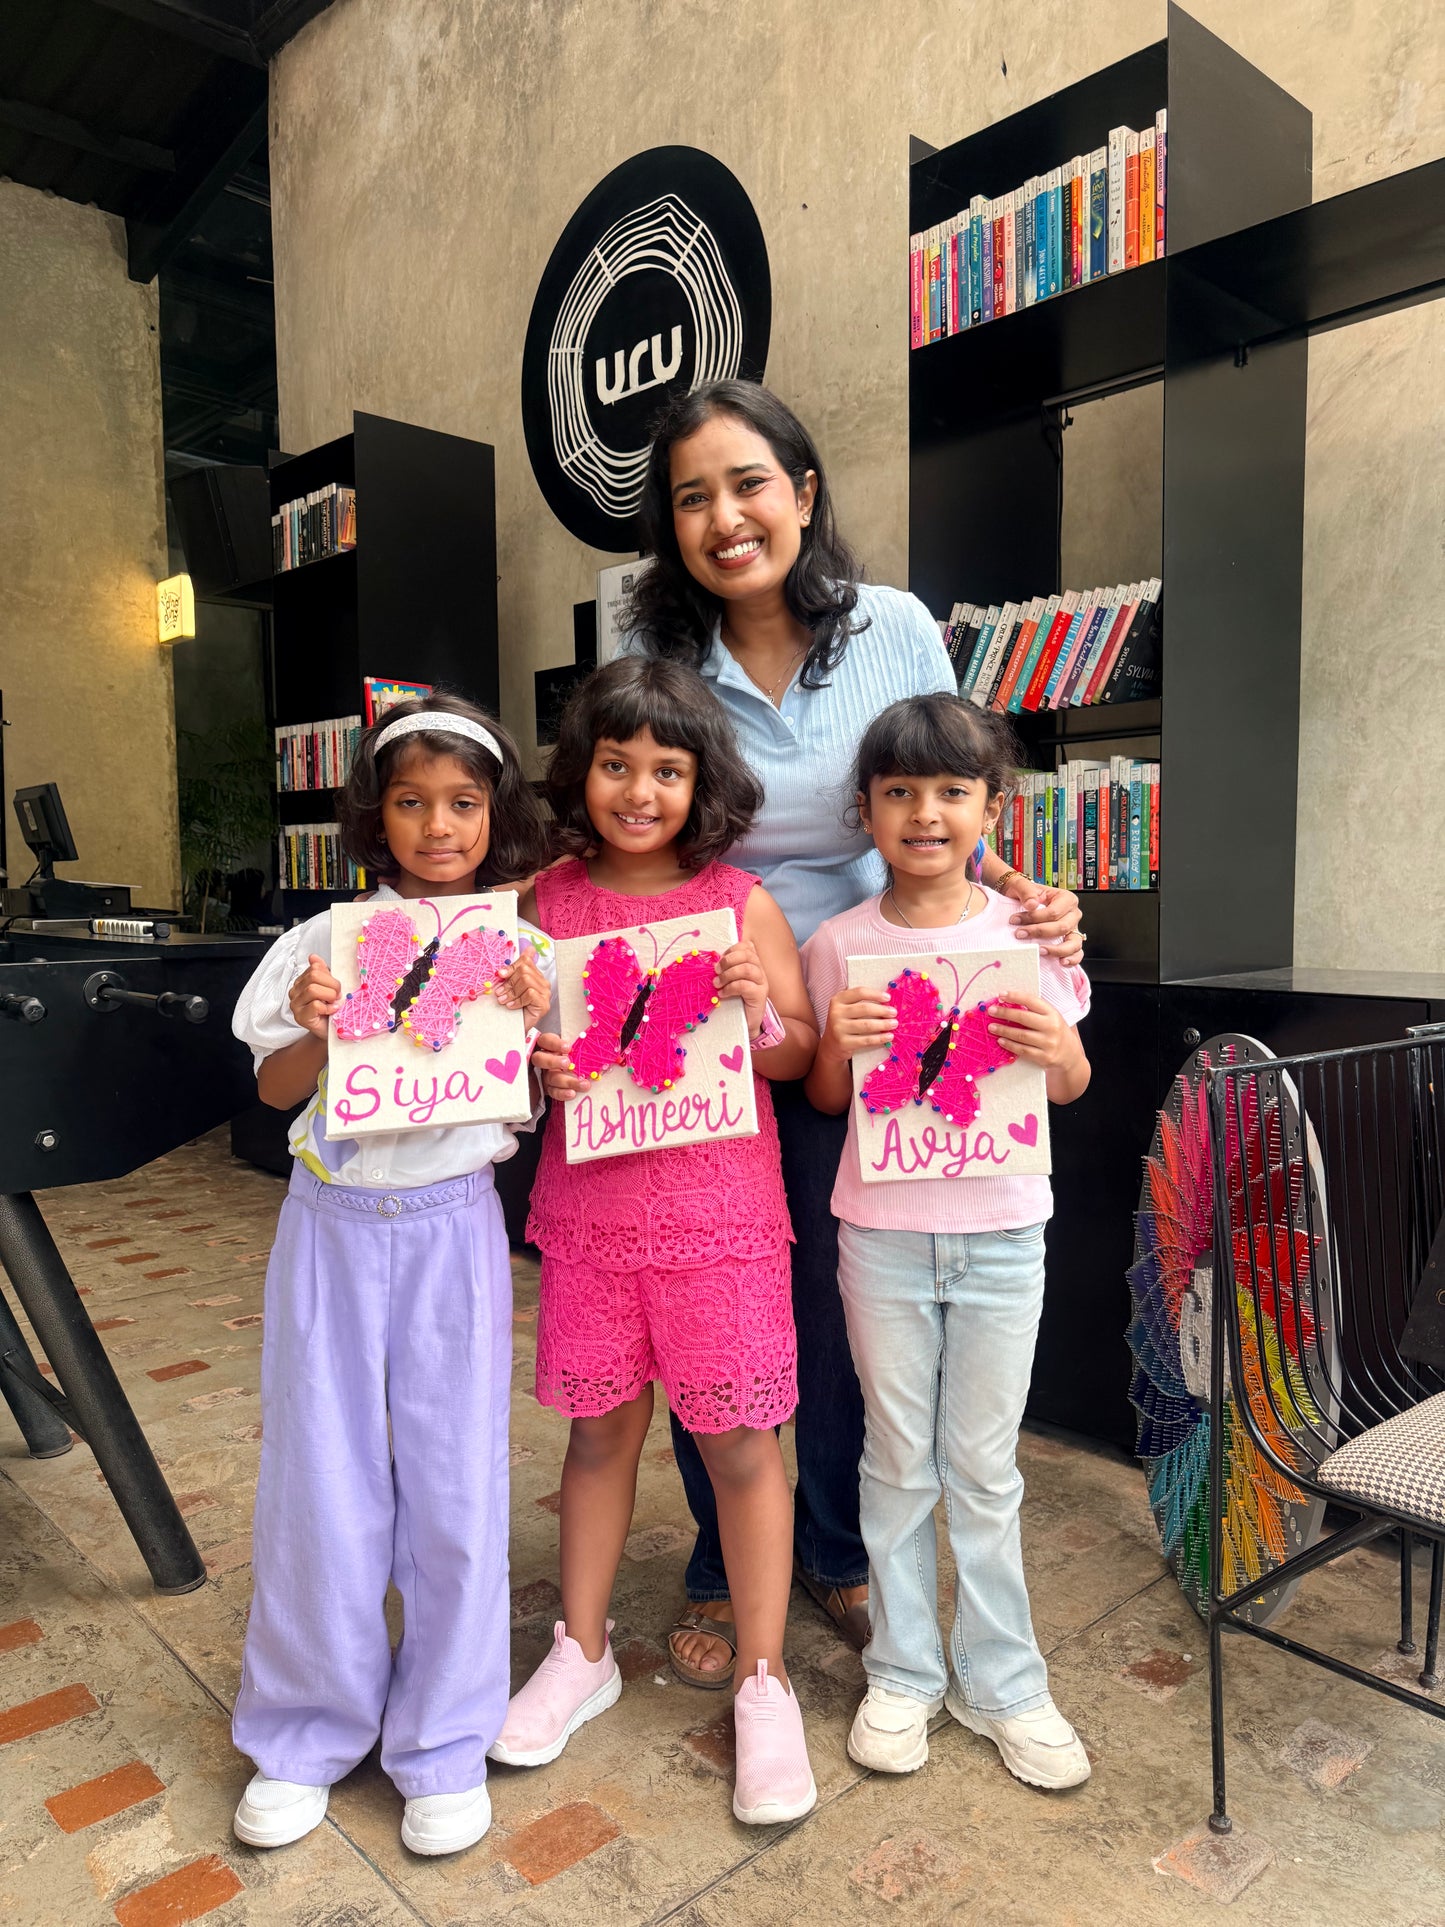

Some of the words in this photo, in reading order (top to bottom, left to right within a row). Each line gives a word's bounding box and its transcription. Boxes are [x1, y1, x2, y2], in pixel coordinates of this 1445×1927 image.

[974, 625, 990, 658] AMERICAN
[1050, 625, 1062, 645] MAAS
[1067, 615, 1082, 636] FIVE
[1006, 649, 1022, 682] DECEPTION
[1115, 646, 1131, 668] SYLVIA
[1126, 664, 1155, 681] SYLVIA
[962, 658, 979, 690] MARRIAGE
[1110, 667, 1122, 682] DAY
[1085, 829, 1097, 862] ADVENTURES
[334, 1064, 484, 1127] Siya
[571, 1080, 744, 1151] Ashneeri
[871, 1118, 1011, 1178] Avya
